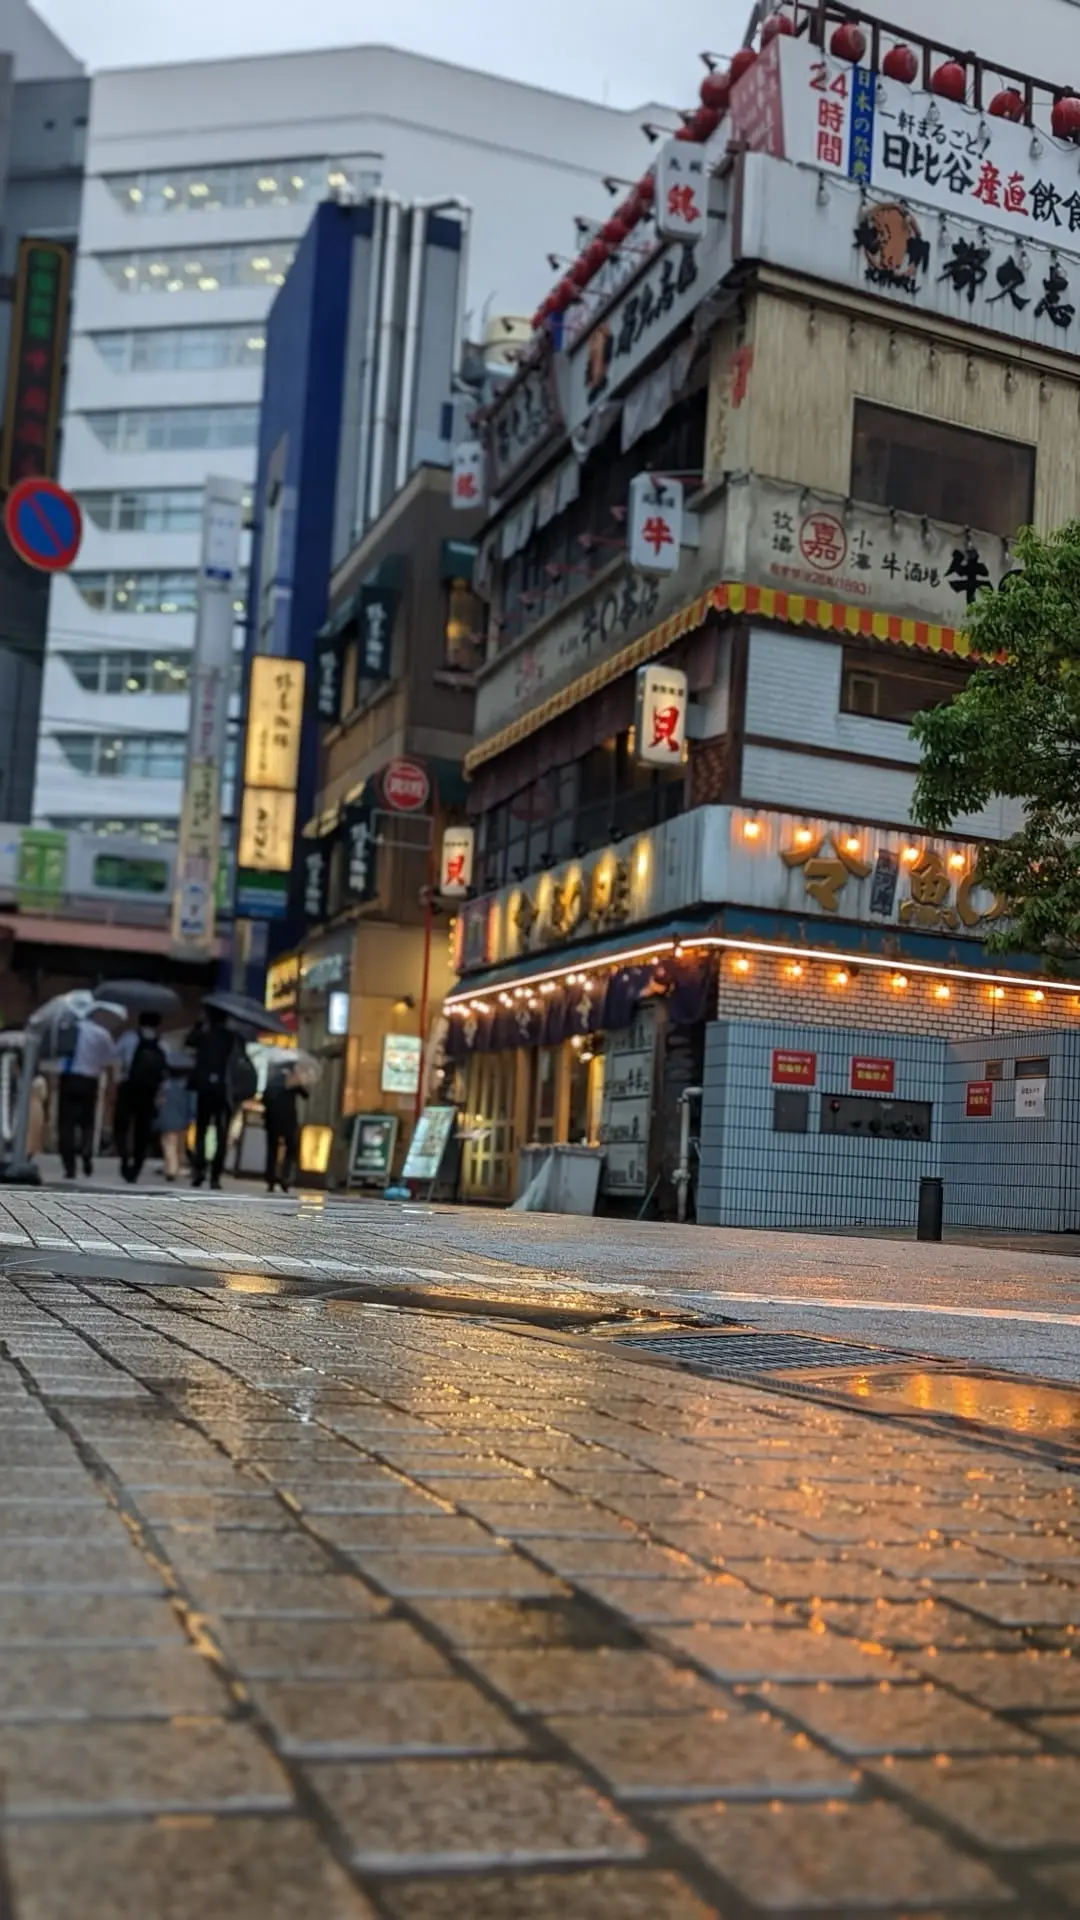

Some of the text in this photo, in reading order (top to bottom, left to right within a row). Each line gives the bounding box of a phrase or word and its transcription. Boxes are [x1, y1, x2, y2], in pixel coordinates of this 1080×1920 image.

[642, 516, 675, 556] 牛
[944, 549, 1022, 605] 牛
[648, 705, 680, 752] 貝
